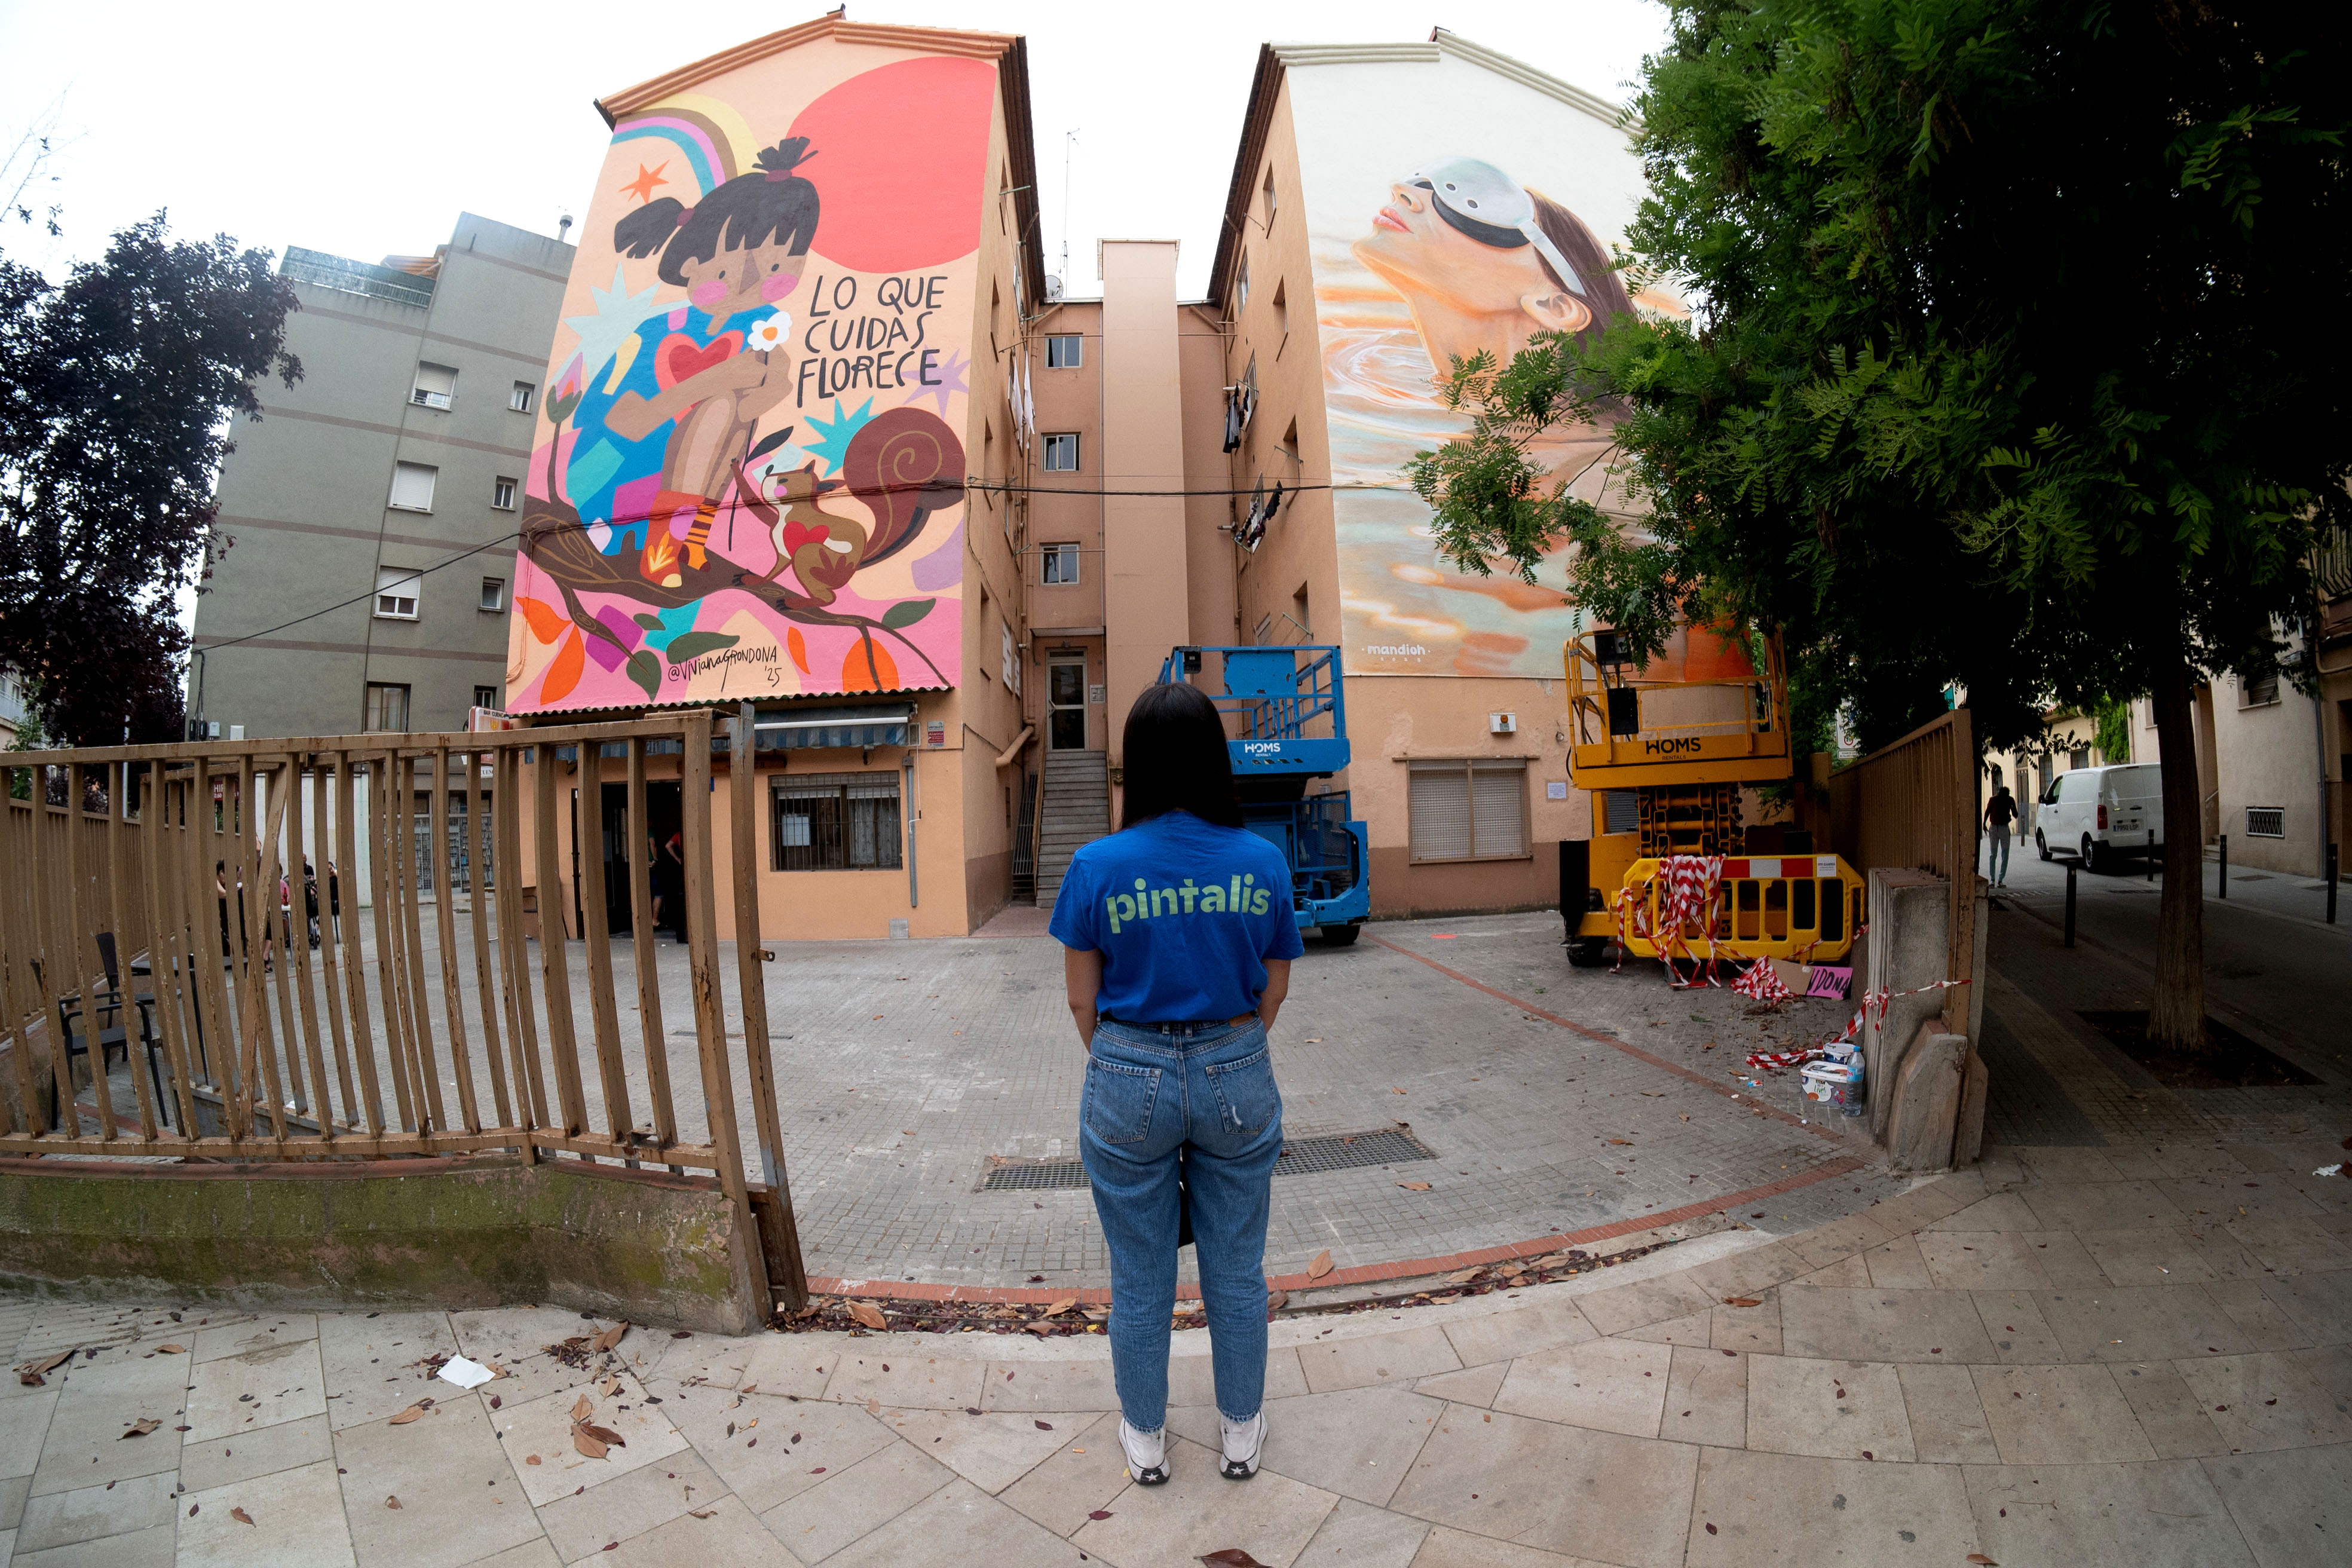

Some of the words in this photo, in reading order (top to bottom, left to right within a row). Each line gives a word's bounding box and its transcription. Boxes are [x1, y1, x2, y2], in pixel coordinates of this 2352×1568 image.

[810, 275, 857, 317] LO
[877, 276, 948, 315] QUE
[805, 311, 933, 353] CUIDAS
[797, 349, 942, 408] FLORECE
[1245, 743, 1281, 753] HOMS
[1646, 737, 1701, 754] HOMS
[1106, 873, 1272, 933] pintalis
